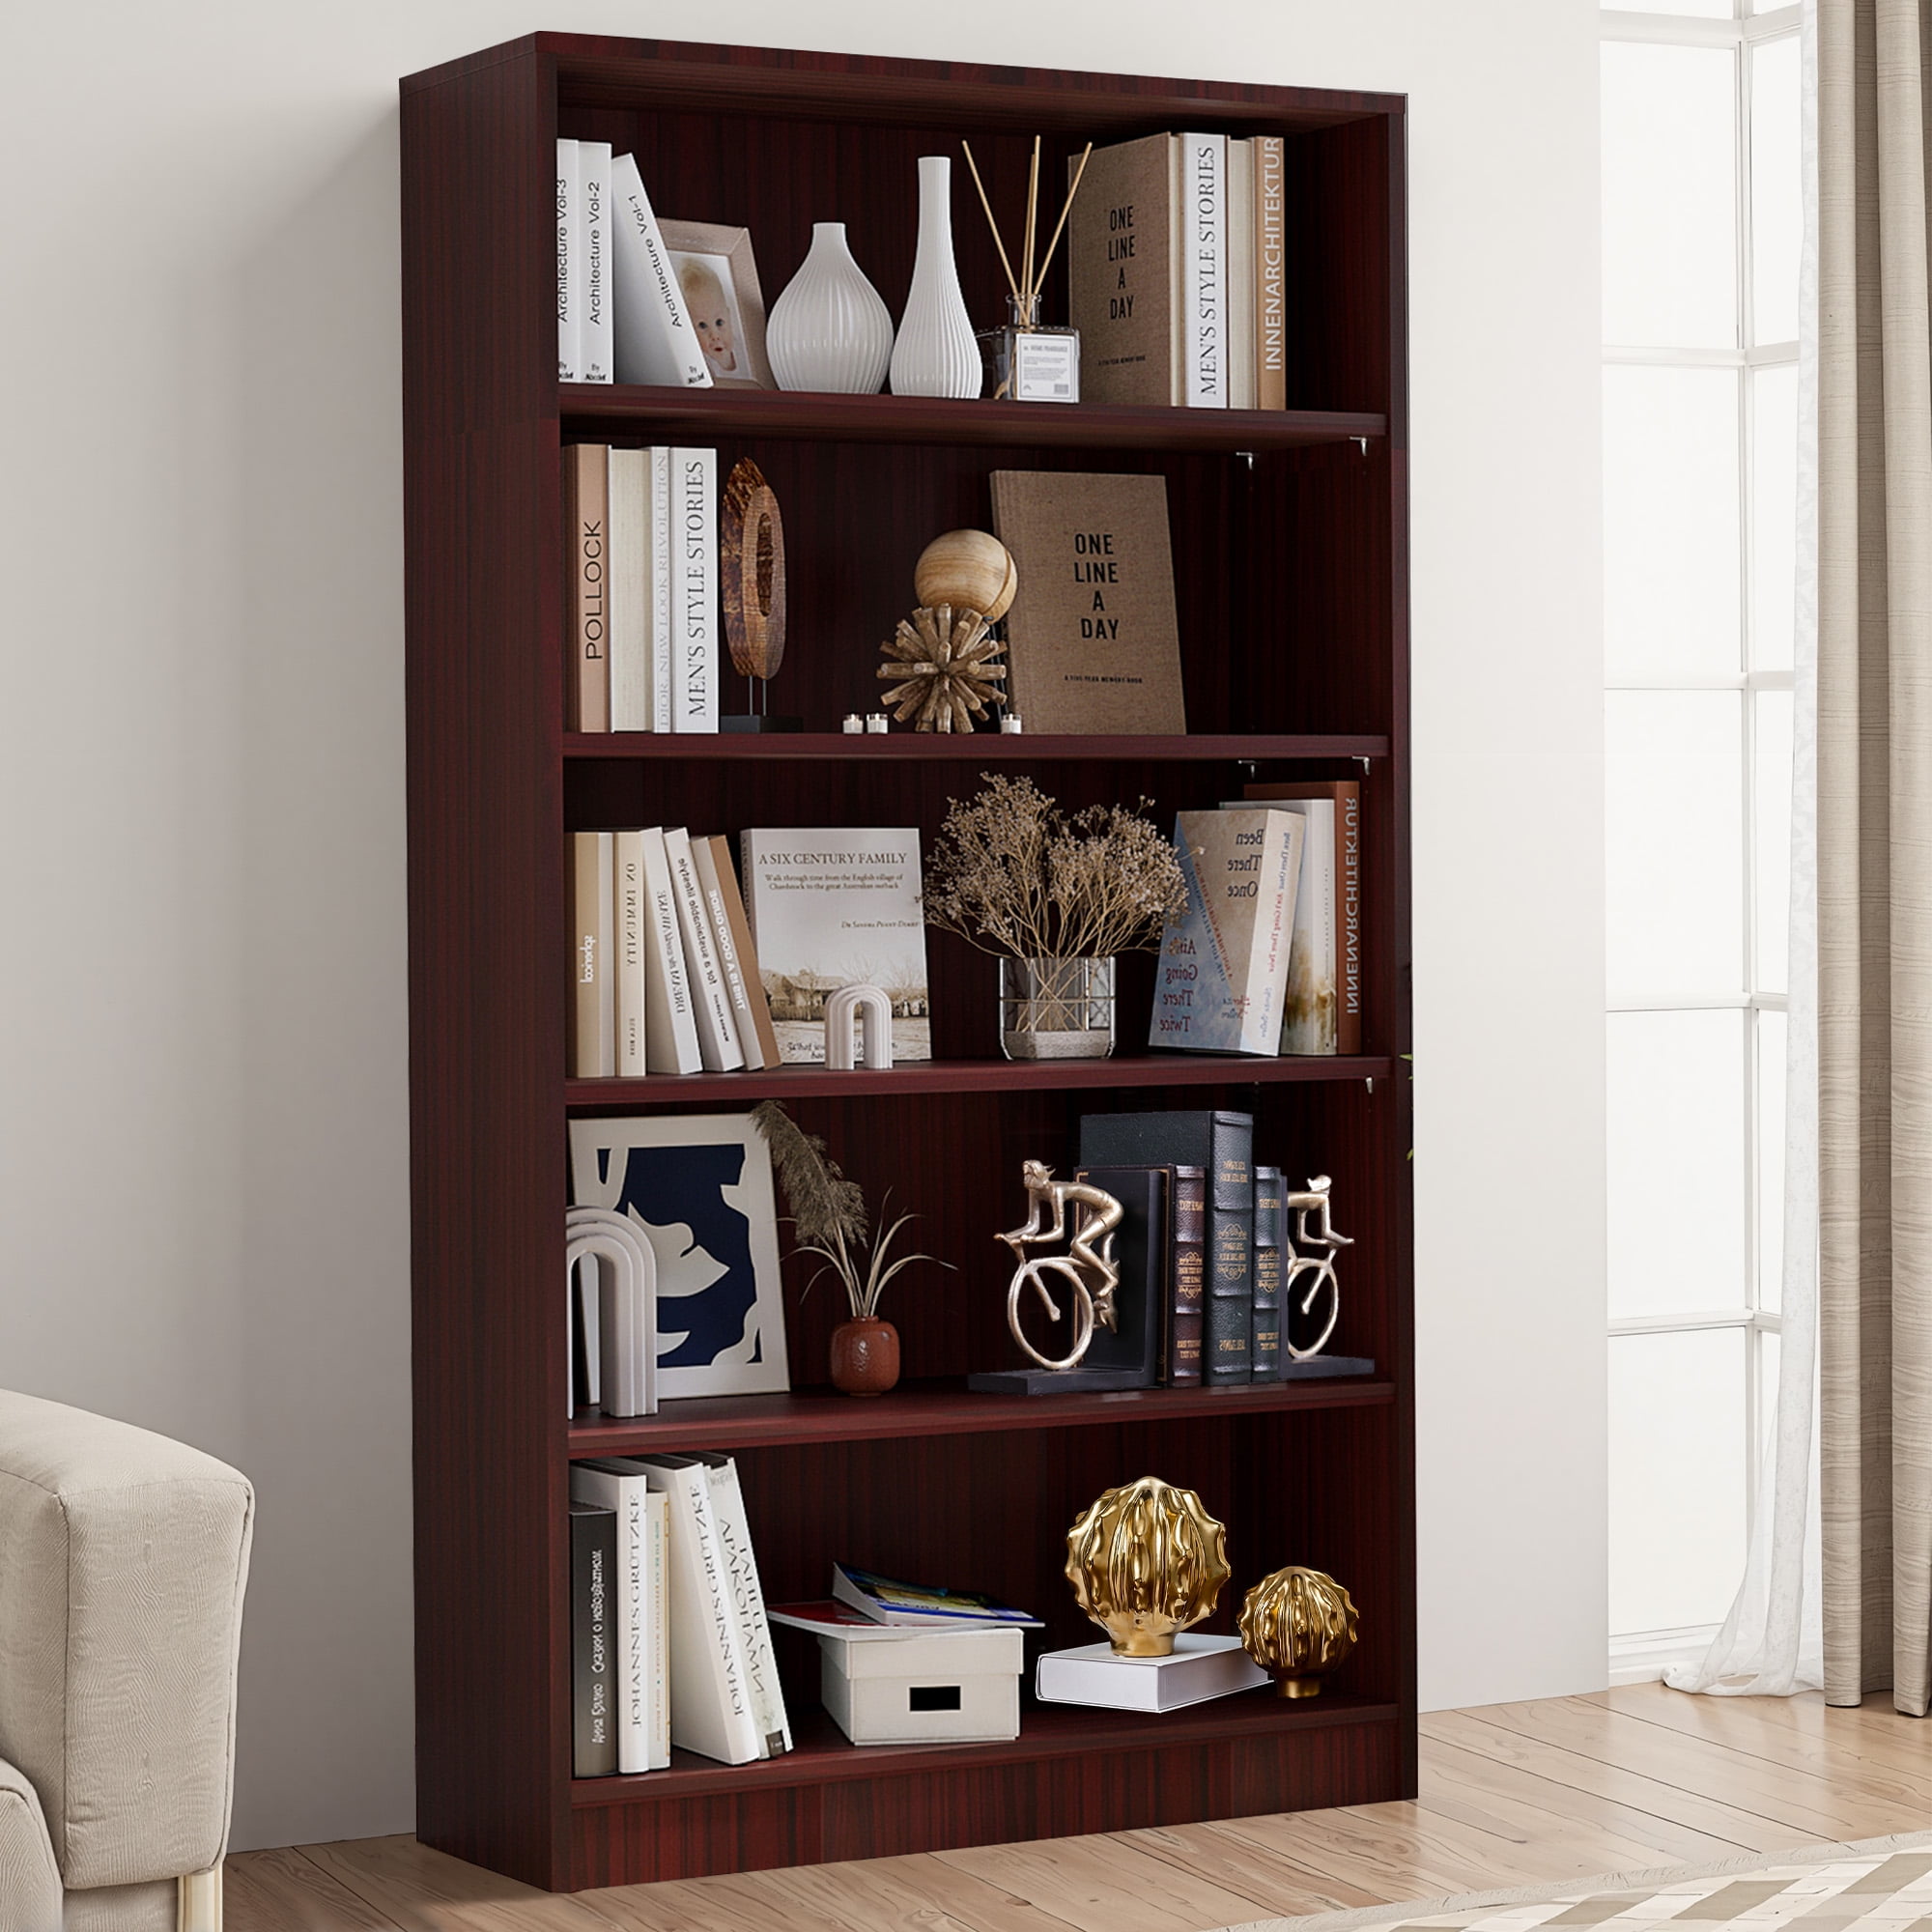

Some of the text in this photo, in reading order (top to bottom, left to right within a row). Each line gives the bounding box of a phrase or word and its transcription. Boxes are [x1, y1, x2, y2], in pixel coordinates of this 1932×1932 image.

[1109, 205, 1134, 232] ONE
[556, 179, 568, 323] Architecture Vol-3
[587, 182, 602, 326] Architecture Vol-2
[628, 195, 683, 328] Architecture Vol-1
[1108, 235, 1136, 262] LINE
[1197, 146, 1217, 396] MEN'S STYLE STORIES
[1264, 137, 1282, 371] INNENARCHITEKTUR
[1118, 267, 1126, 290] A
[1110, 295, 1135, 320] DAY
[656, 454, 668, 571] REVOLUTION
[1074, 533, 1114, 555] ONE
[583, 520, 604, 660] POLLOCK
[685, 460, 706, 717] MEN'S STYLE STORIES
[1073, 562, 1119, 583] LINE
[657, 577, 668, 627] LOOK
[1093, 590, 1105, 611] A
[658, 633, 668, 673] NEW
[1080, 618, 1120, 640] DAY
[758, 852, 908, 865] A SIX CENTURY FAMILY
[631, 1606, 642, 1729] JOHANNES
[711, 1595, 744, 1717] JOHANNES
